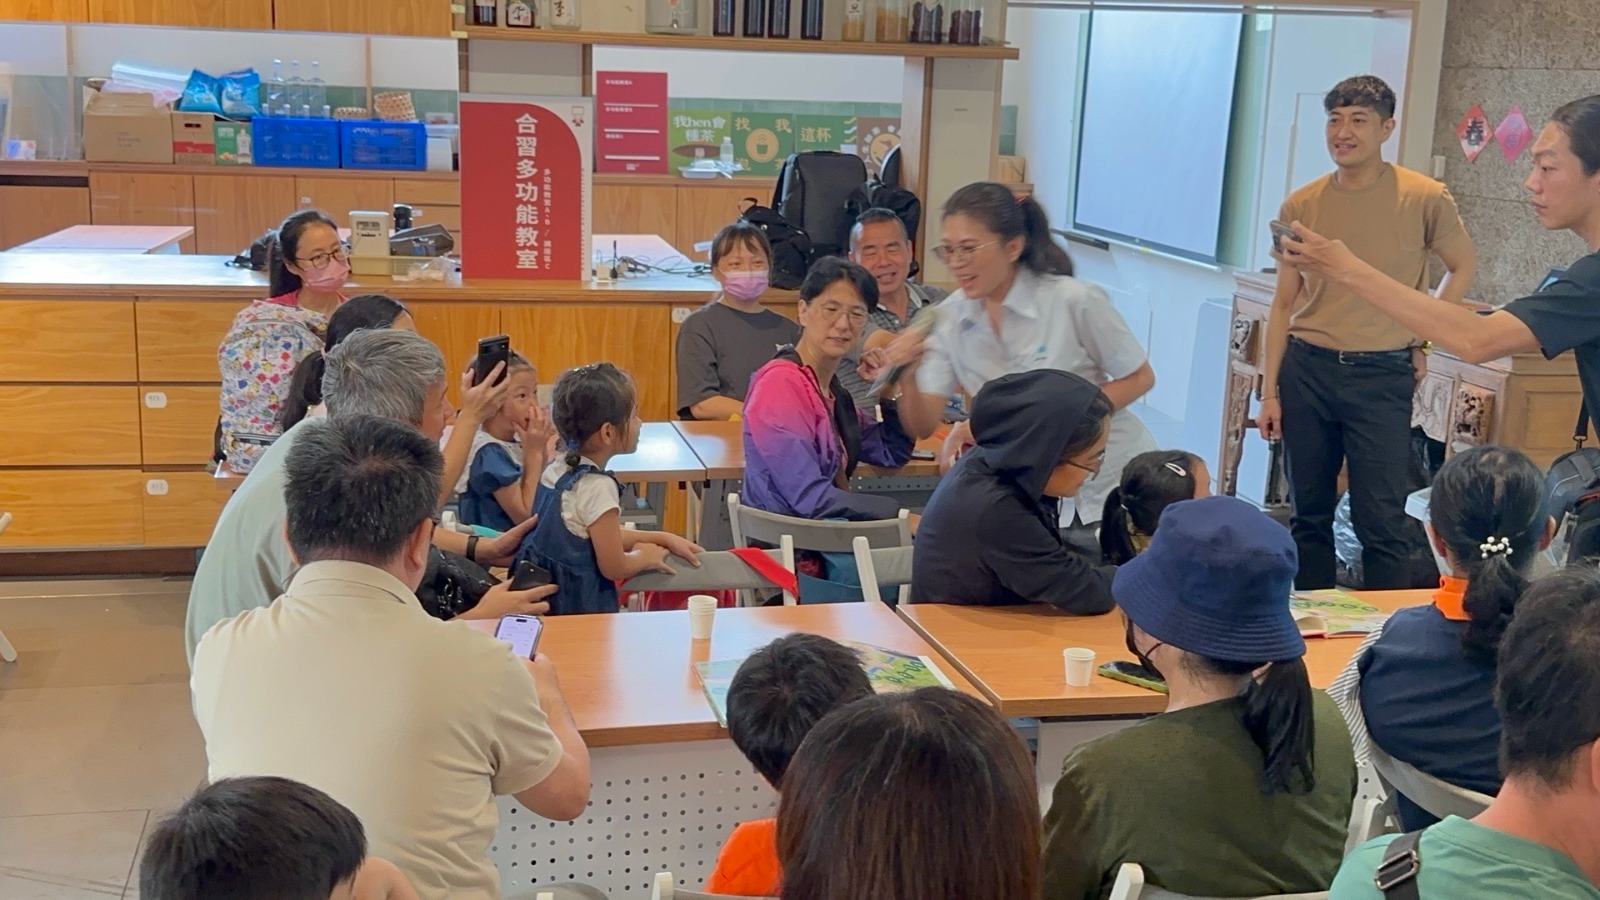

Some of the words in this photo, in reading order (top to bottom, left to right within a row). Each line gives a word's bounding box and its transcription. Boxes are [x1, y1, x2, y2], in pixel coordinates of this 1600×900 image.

[674, 115, 727, 129] 我hen會
[735, 117, 751, 131] 找
[775, 118, 792, 133] 我
[686, 129, 715, 143] 種茶
[800, 127, 832, 143] 這杯
[515, 113, 539, 270] 合習多功能教室
